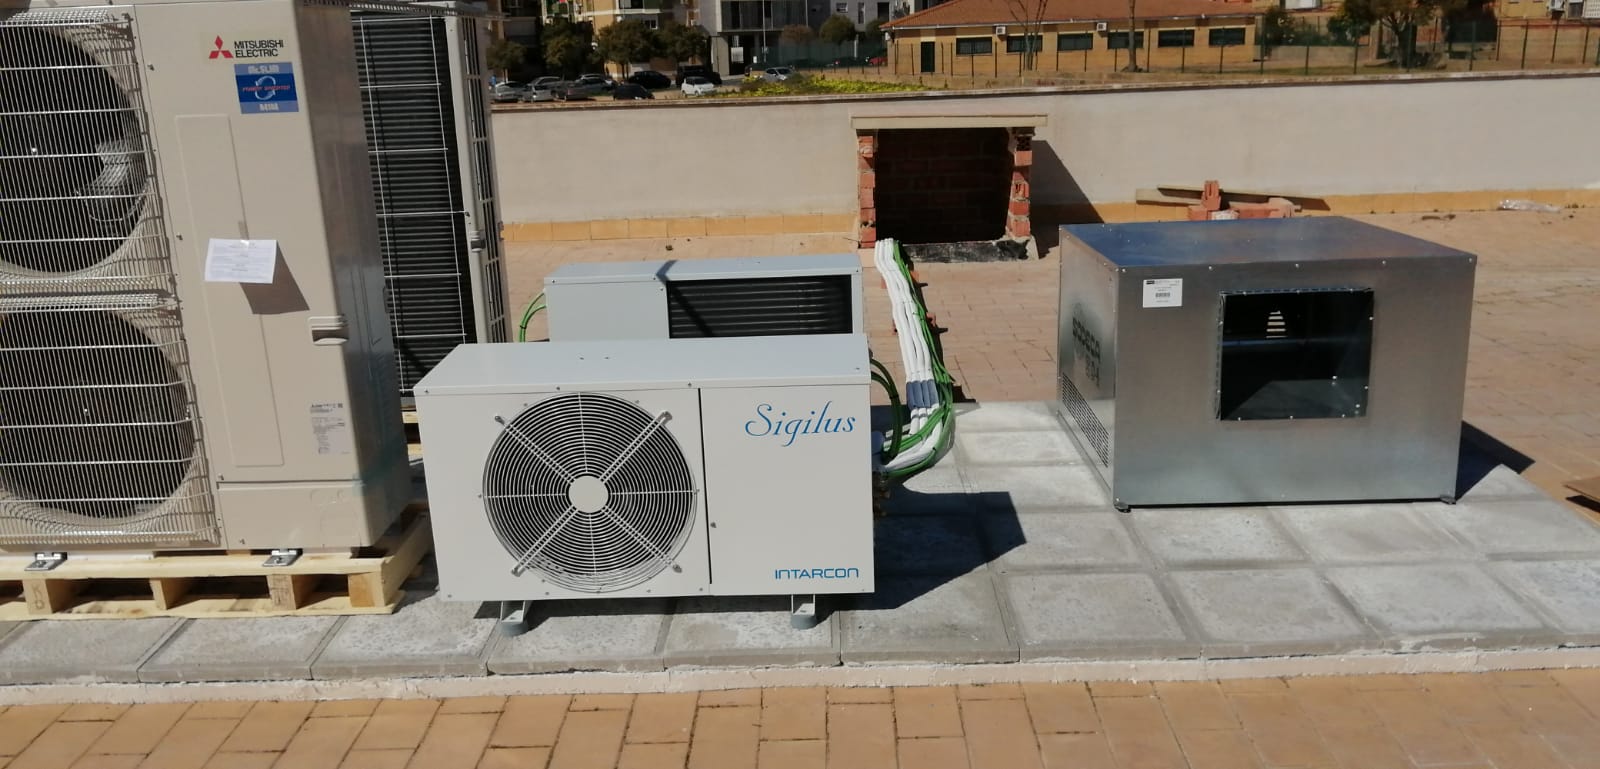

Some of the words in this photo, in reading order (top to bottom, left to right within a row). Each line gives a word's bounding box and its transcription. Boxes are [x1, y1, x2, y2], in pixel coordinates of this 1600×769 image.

[234, 39, 284, 49] MITSUBISHI
[235, 49, 279, 58] ELECTRIC
[745, 400, 856, 447] Sigilus
[775, 568, 859, 579] INTARCON
